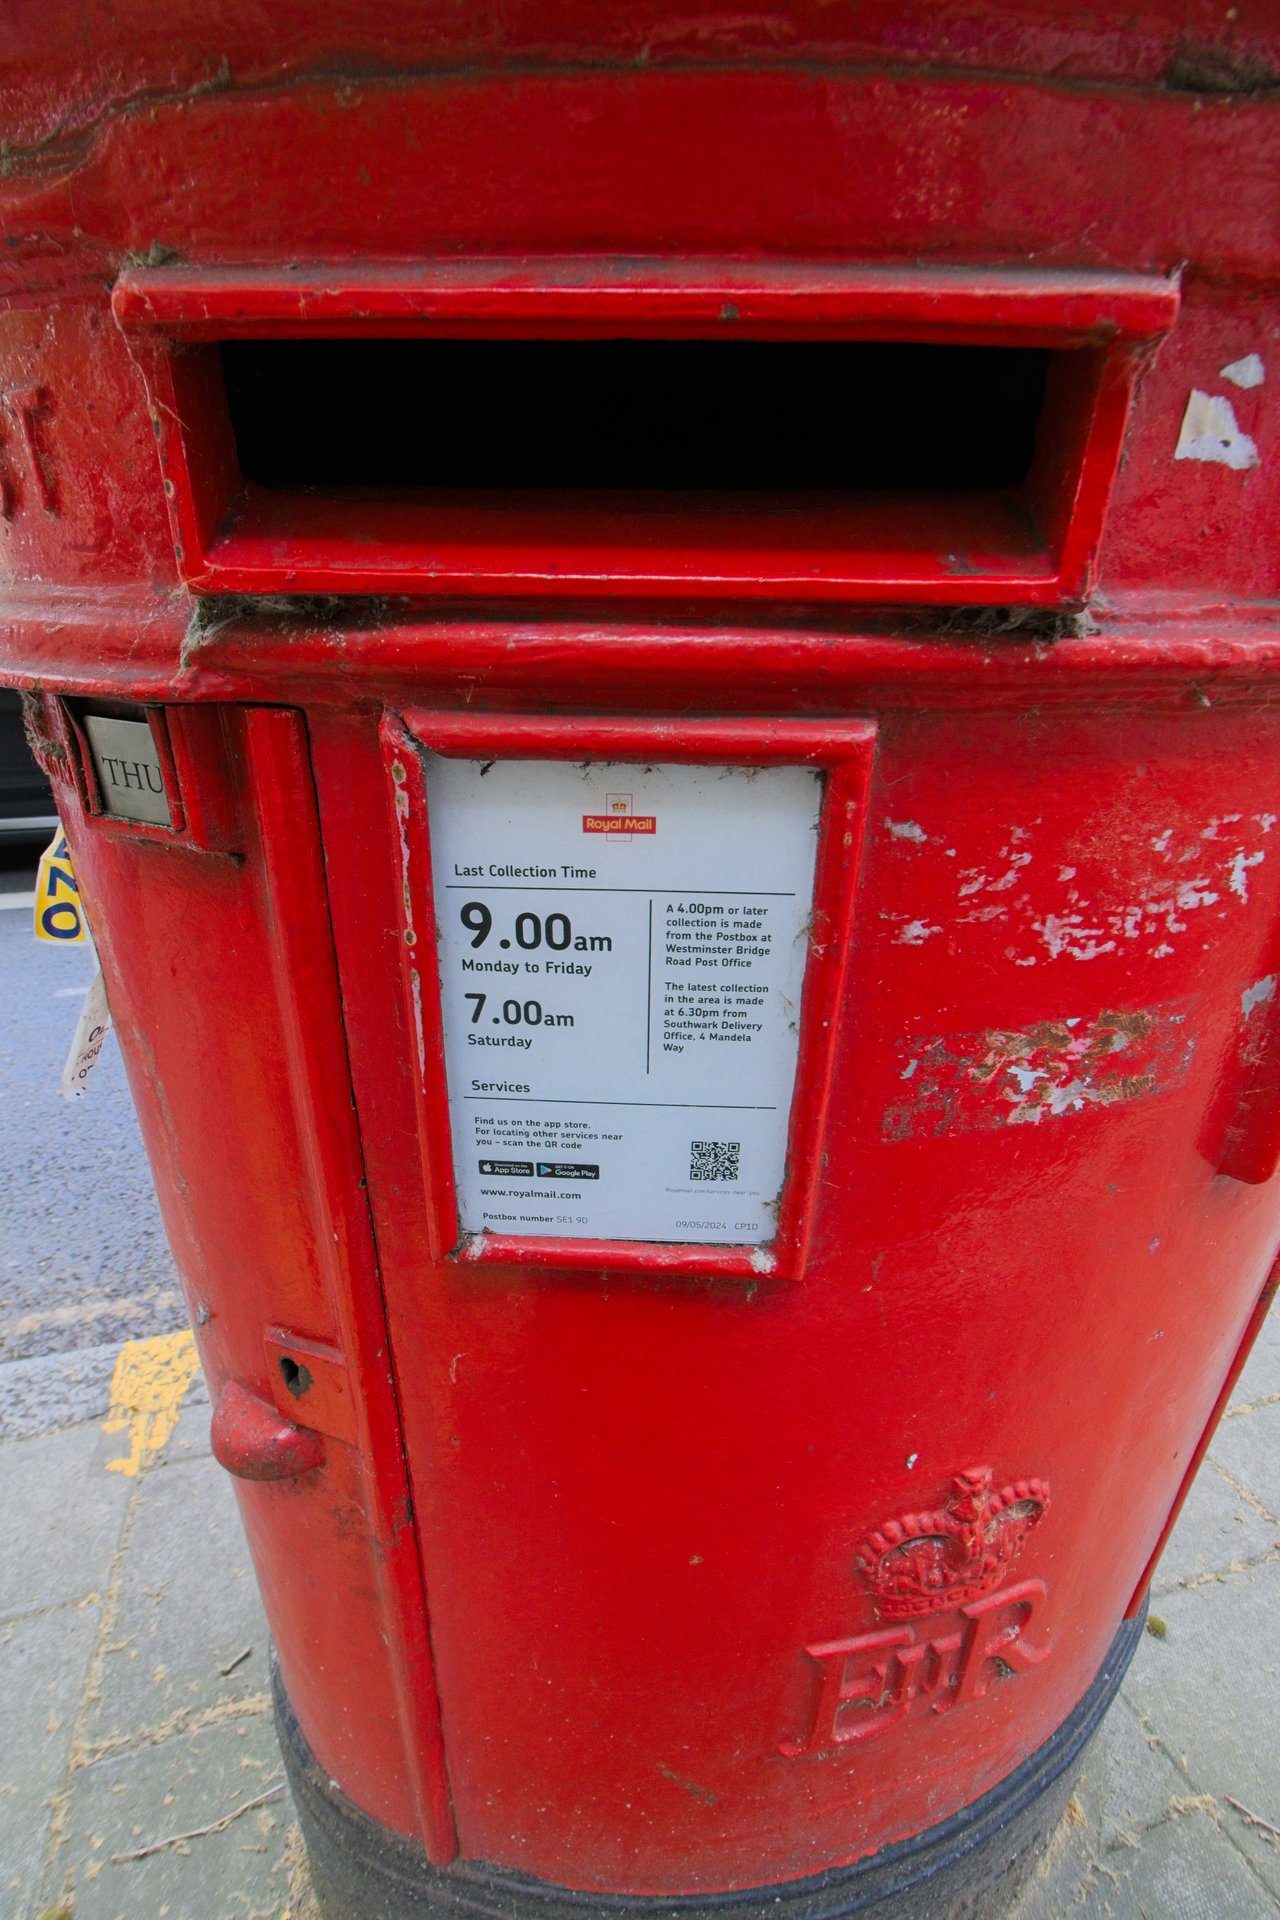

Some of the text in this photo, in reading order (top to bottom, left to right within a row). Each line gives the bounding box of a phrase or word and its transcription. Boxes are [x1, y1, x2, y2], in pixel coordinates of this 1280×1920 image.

[101, 756, 165, 794] THU
[586, 818, 652, 832] Royal Mail
[454, 865, 597, 878] Last Collection Time
[667, 903, 768, 916] A 4.00pm or later
[460, 901, 612, 951] 9.00am
[667, 918, 762, 928] collection is made
[667, 931, 772, 942] from the Postbox at
[666, 944, 770, 957] Westminster Bridge
[462, 960, 592, 977] Monday to Friday
[666, 958, 752, 968] Road Post Office
[665, 982, 768, 993] The latest collection
[665, 995, 673, 1003] in
[676, 995, 694, 1003] the
[736, 997, 763, 1005] made
[464, 993, 574, 1027] 7.00am
[664, 1007, 747, 1019] at 6.30pm from
[663, 1020, 762, 1032] Southwark Delivery
[468, 1034, 532, 1049] Saturday
[663, 1032, 751, 1042] Office, 4 Mandela
[663, 1043, 684, 1053] Way
[471, 1080, 530, 1093] Services
[475, 1117, 493, 1125] Find
[526, 1119, 541, 1127] the
[545, 1121, 561, 1129] app
[565, 1121, 591, 1129] store.
[493, 1128, 529, 1138] locating
[533, 1130, 557, 1138] other
[561, 1132, 598, 1140] services
[476, 1139, 492, 1147] you
[561, 1141, 582, 1149] code
[555, 1169, 580, 1177] Google
[480, 1188, 581, 1199] www.royalmail.com
[483, 1212, 516, 1221] Postbox
[675, 1220, 727, 1229] 09/05/2024
